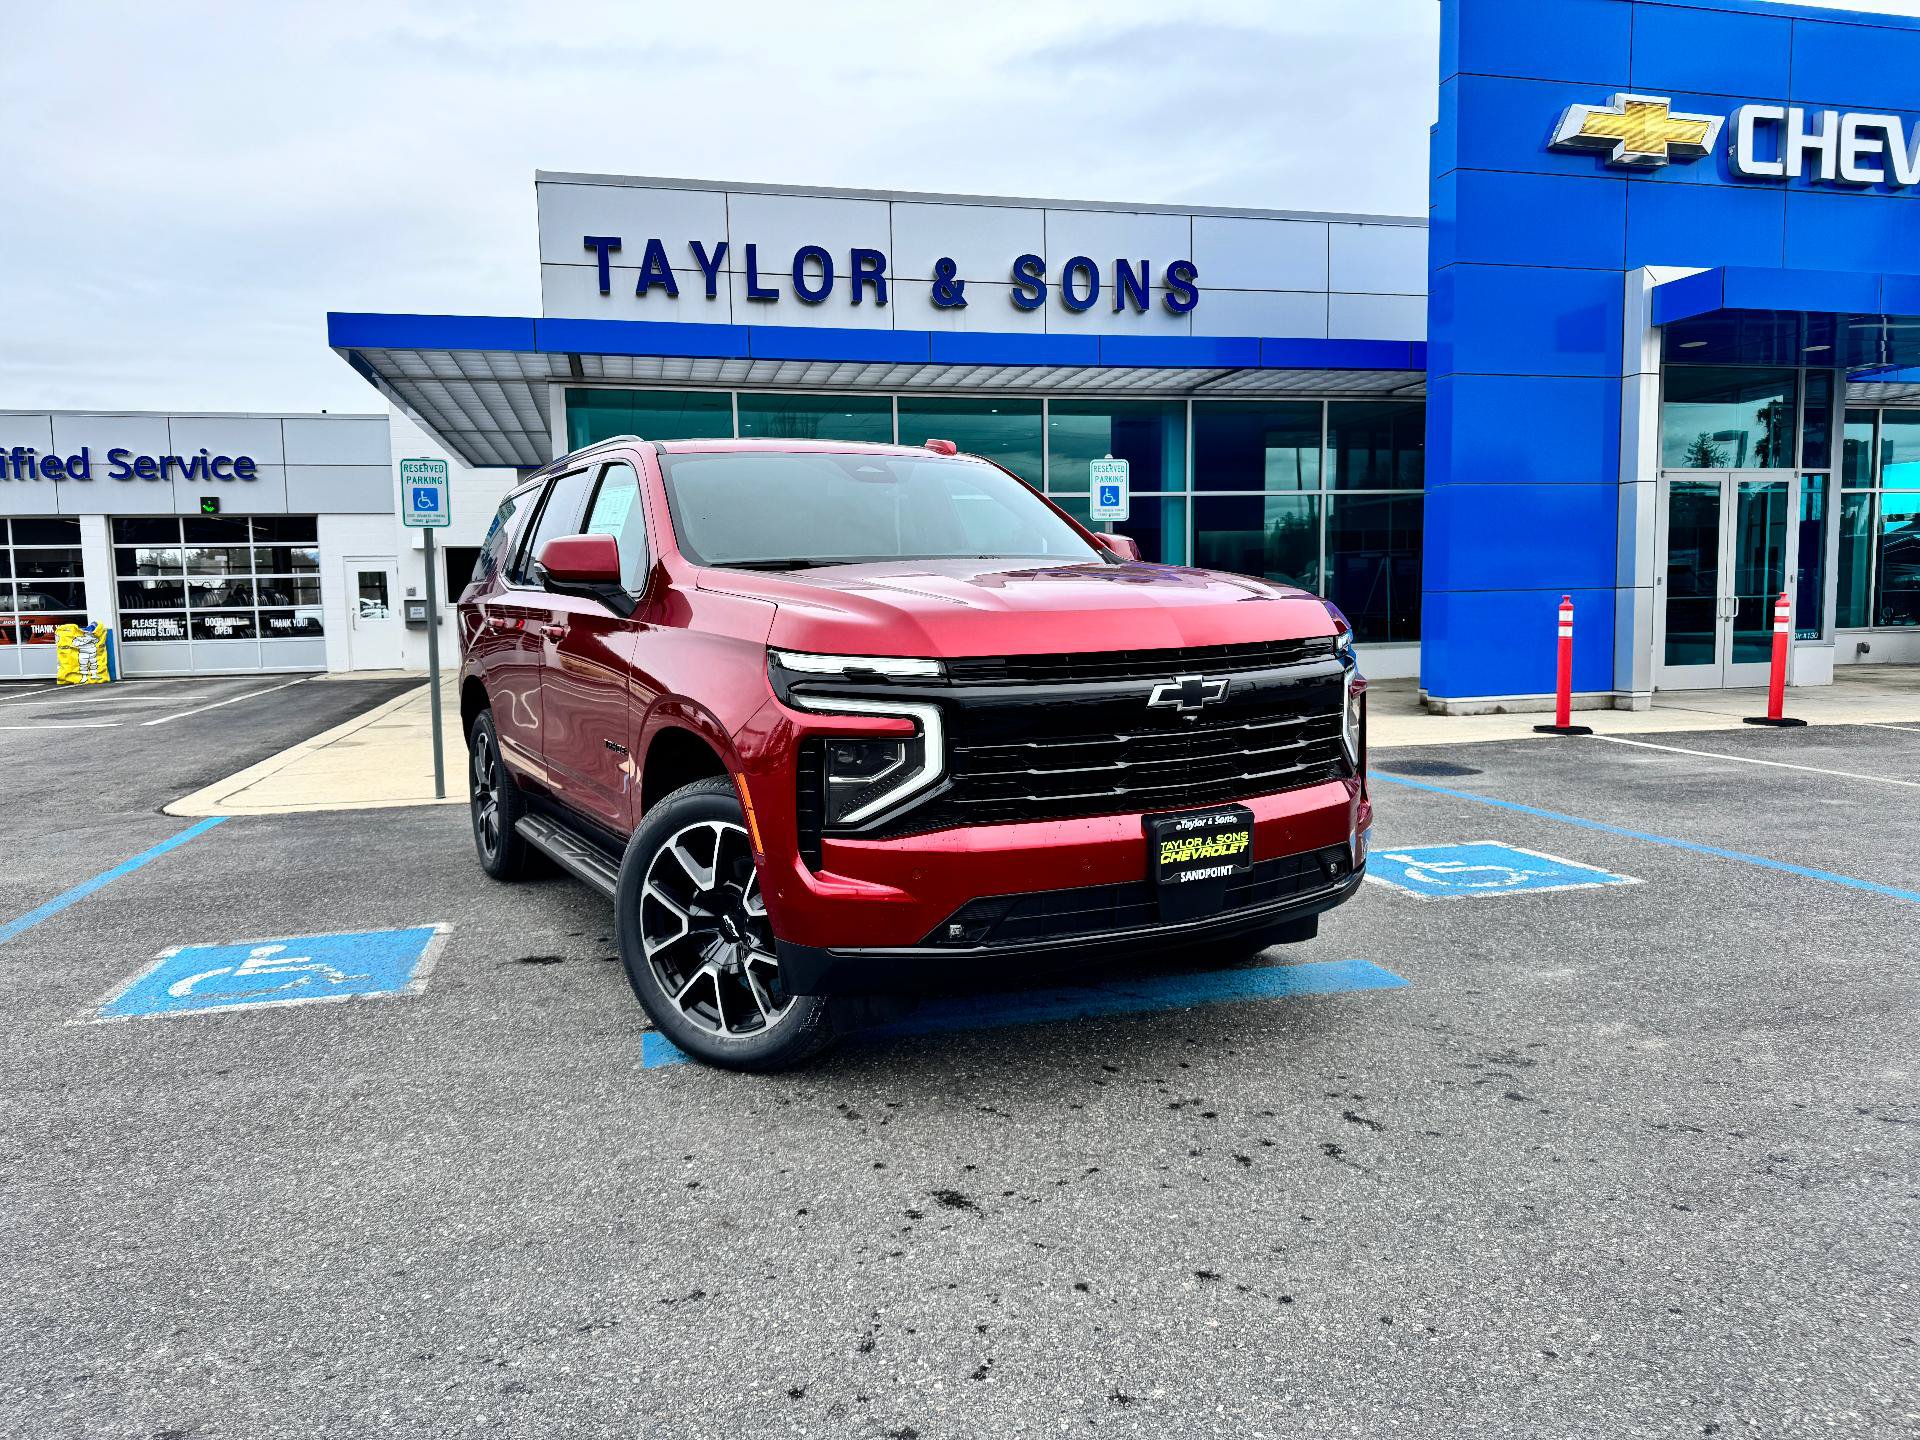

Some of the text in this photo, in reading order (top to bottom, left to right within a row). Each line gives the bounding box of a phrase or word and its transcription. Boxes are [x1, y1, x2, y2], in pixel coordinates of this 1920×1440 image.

[1730, 104, 1920, 186] CHEV
[583, 235, 1200, 314] TAYLOR & SONS
[107, 448, 257, 481] Service
[403, 464, 444, 473] RESERVED
[1093, 465, 1125, 473] RESERVED
[406, 476, 443, 485] PARKING
[1095, 475, 1124, 483] PARKING
[131, 618, 175, 628] PLEASE PULL
[204, 617, 223, 626] DOOR
[269, 618, 308, 628] THANK YOU!
[30, 624, 54, 634] THANK
[123, 626, 185, 637] FORWARD SLOWLY
[214, 626, 233, 635] OPEN
[1180, 815, 1234, 830] Taylor & Sons
[1160, 831, 1249, 852] TAYLOR & SONS
[1160, 841, 1249, 865] CHEVROLET
[1180, 864, 1234, 883] SANDPOINT
